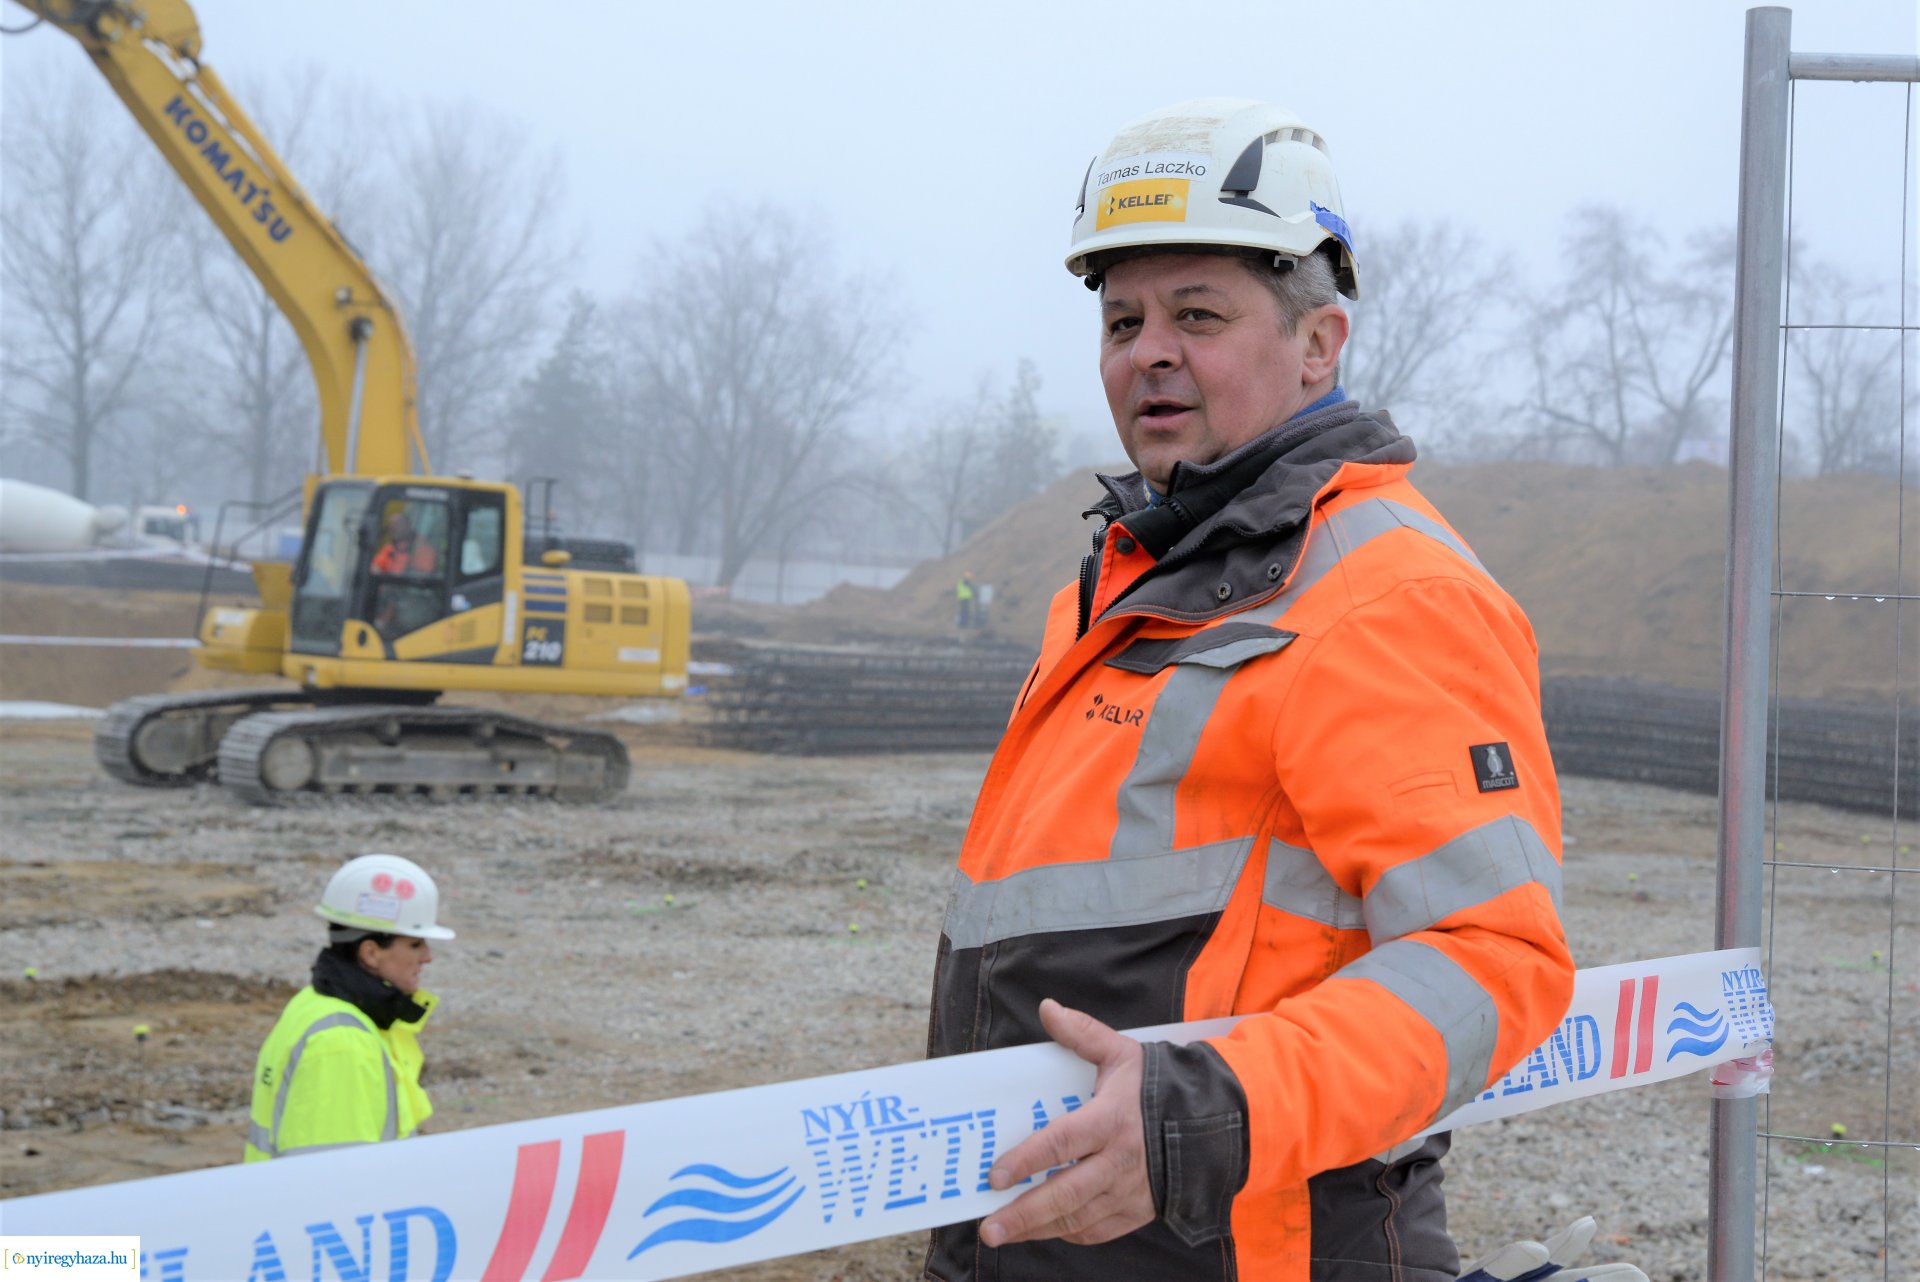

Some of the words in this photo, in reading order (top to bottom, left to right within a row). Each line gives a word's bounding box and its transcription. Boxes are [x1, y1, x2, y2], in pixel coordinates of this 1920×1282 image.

[164, 96, 293, 243] KOMATSU
[1097, 165, 1140, 187] Tamas
[1145, 161, 1206, 176] Laczko
[524, 641, 562, 661] 210
[1483, 777, 1515, 788] MASCOT
[800, 1090, 920, 1137] NYÍR-
